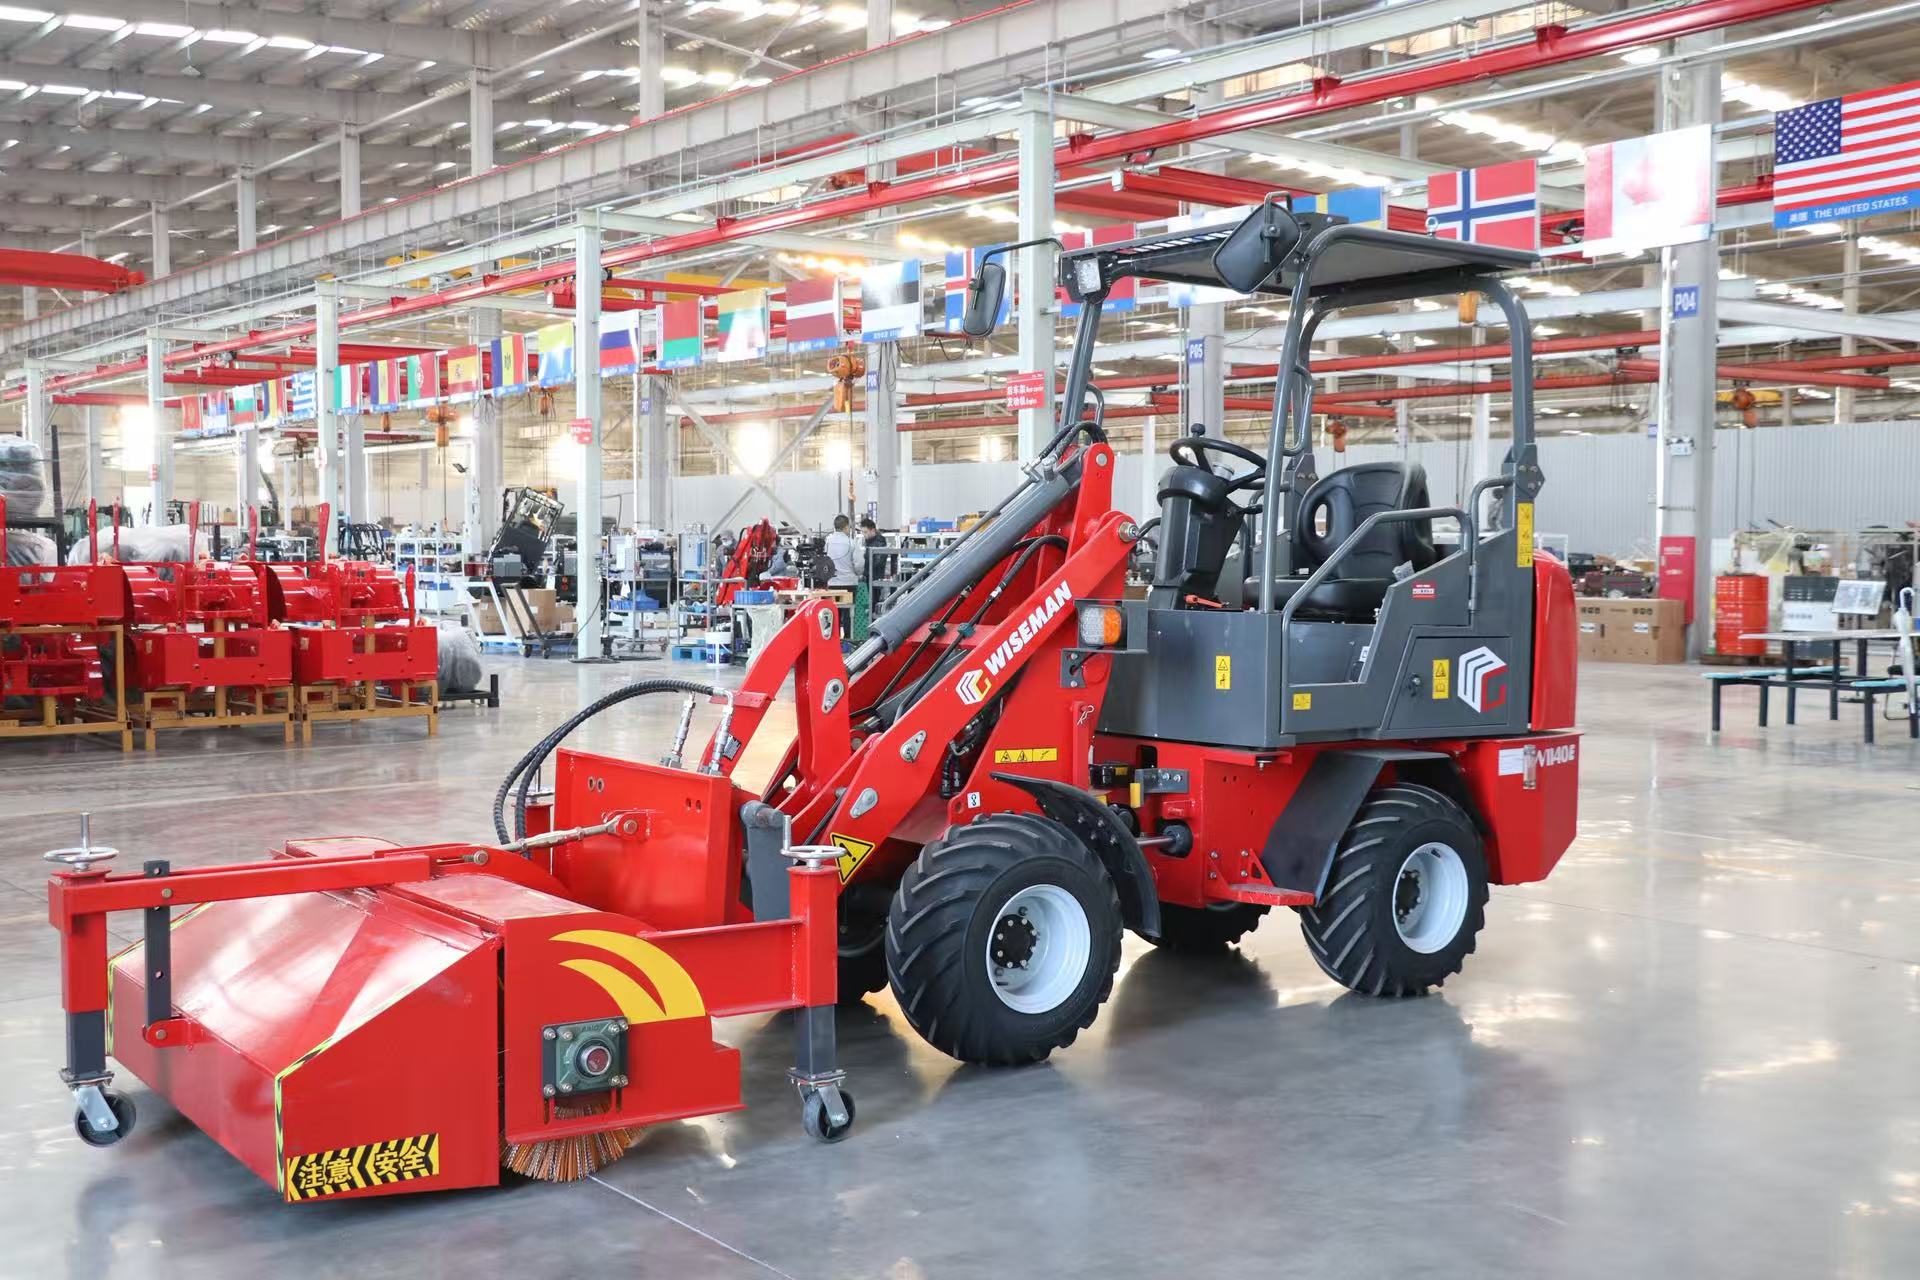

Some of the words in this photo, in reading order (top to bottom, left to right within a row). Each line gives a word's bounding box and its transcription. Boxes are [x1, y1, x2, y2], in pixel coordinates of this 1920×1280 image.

[1814, 207, 1832, 219] THE
[1833, 202, 1870, 217] UNITED
[1871, 195, 1909, 210] STATES
[1674, 291, 1697, 312] P04
[1189, 343, 1203, 359] P05
[983, 580, 1073, 677] WISEMAN
[298, 1157, 353, 1190] 注意
[374, 1145, 427, 1177] 安全
